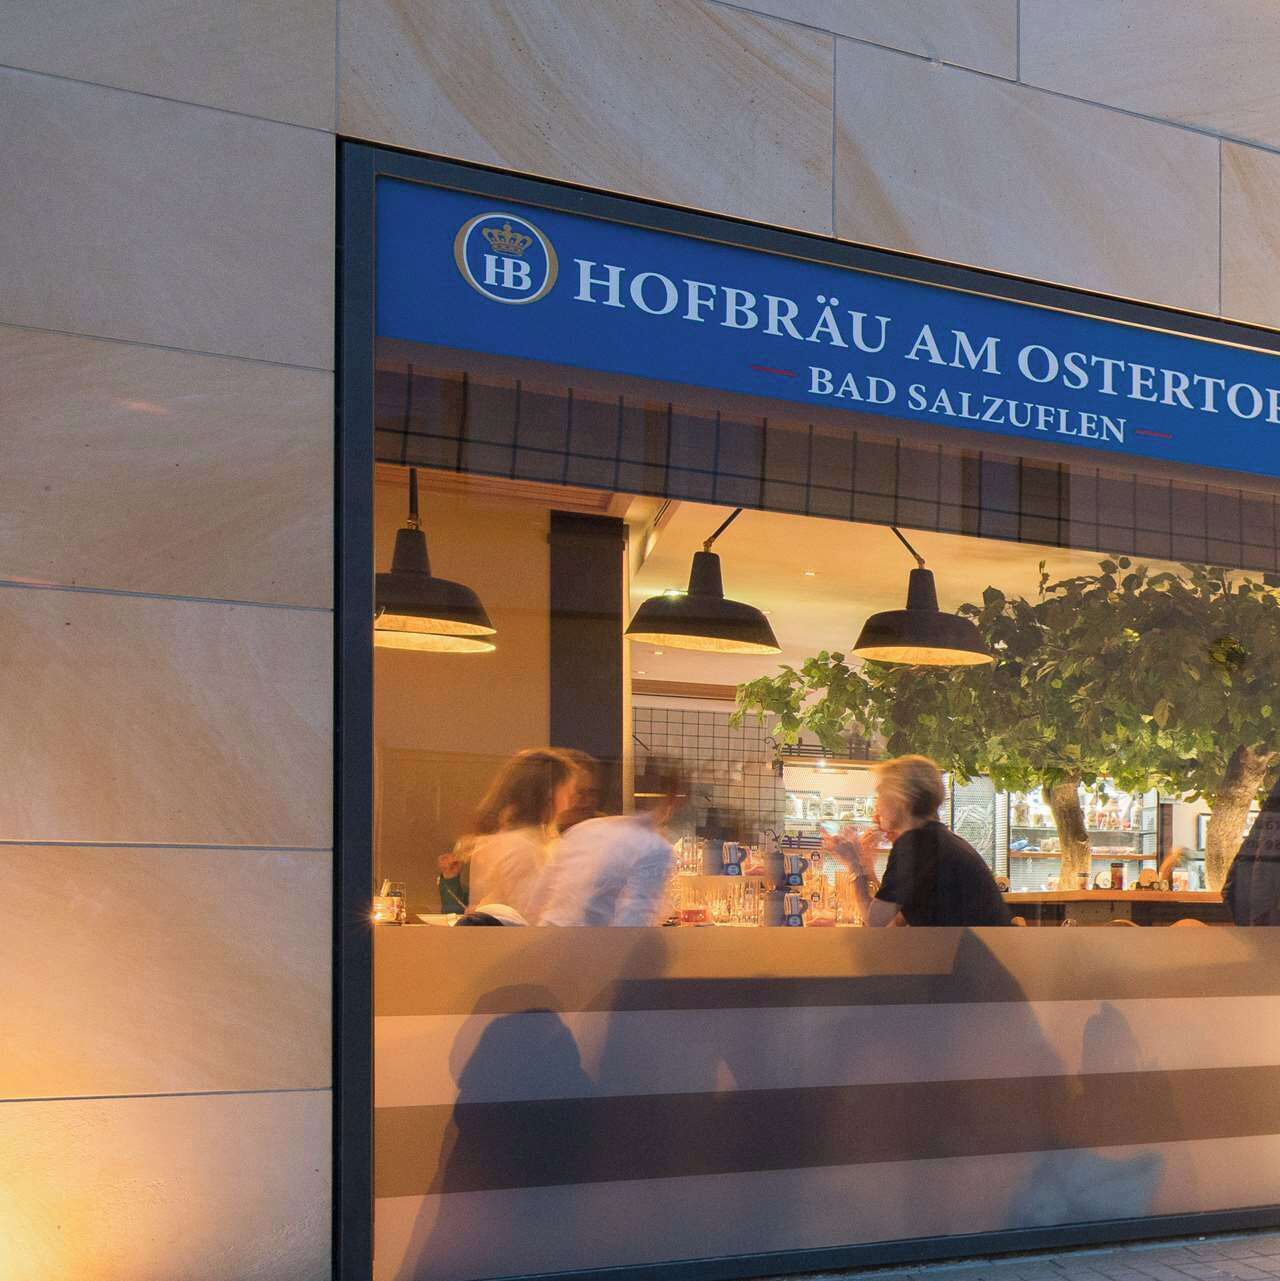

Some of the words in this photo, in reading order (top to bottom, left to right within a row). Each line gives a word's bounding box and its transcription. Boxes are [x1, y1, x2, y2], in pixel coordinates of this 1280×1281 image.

[482, 253, 532, 291] HB
[573, 257, 892, 354] HOFBRÄU
[904, 324, 1001, 375] AM
[807, 366, 897, 404] BAD
[907, 383, 1127, 444] SALZUFLEN
